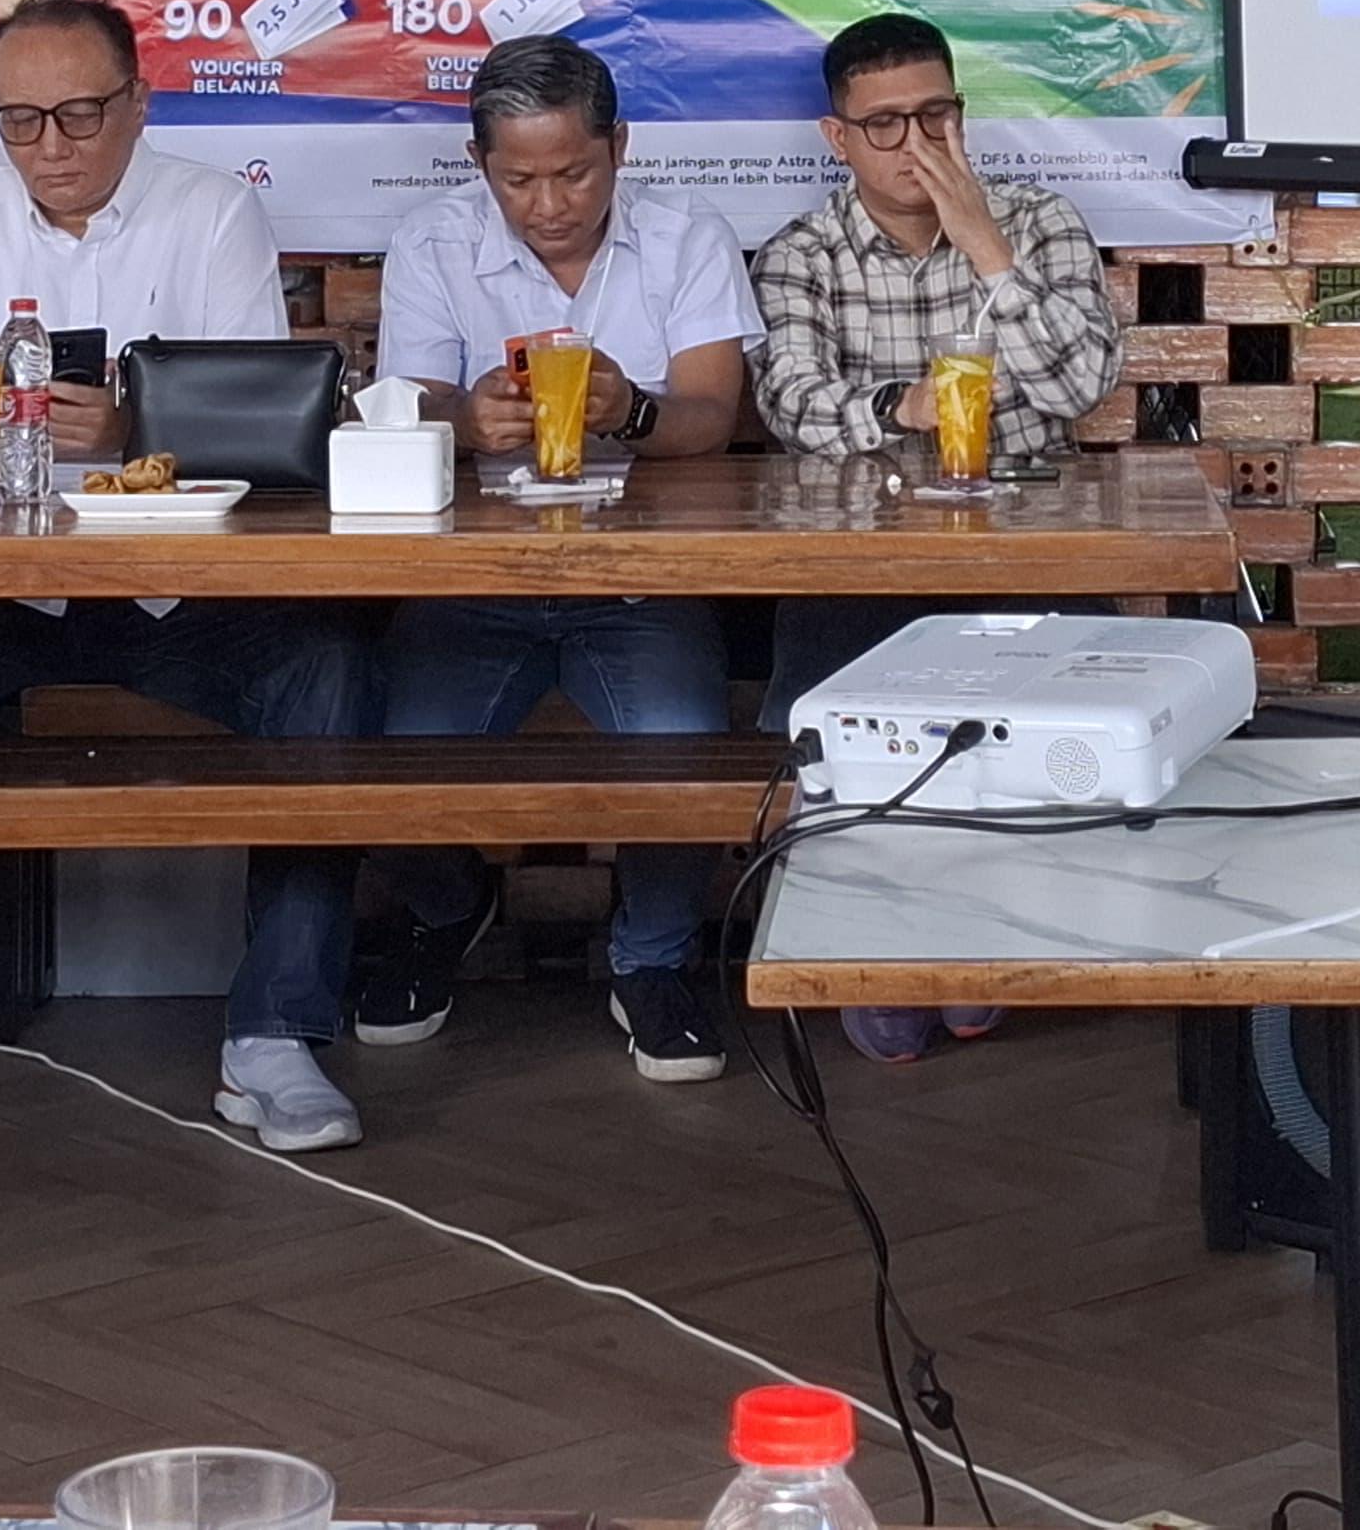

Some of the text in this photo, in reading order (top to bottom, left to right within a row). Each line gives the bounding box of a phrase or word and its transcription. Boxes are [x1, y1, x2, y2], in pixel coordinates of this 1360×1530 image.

[255, 4, 288, 38] 2,5
[498, 8, 515, 25] 1
[189, 59, 284, 76] VOUCHER
[426, 56, 485, 72] VOUC
[192, 79, 281, 95] BELANJA
[665, 156, 725, 170] jaringan
[729, 157, 772, 170] group
[777, 155, 815, 168] Astra
[980, 153, 1011, 165] DFS
[1015, 153, 1026, 165] &
[1112, 152, 1148, 165] akan
[679, 171, 729, 185] undian
[733, 171, 769, 184] lebih
